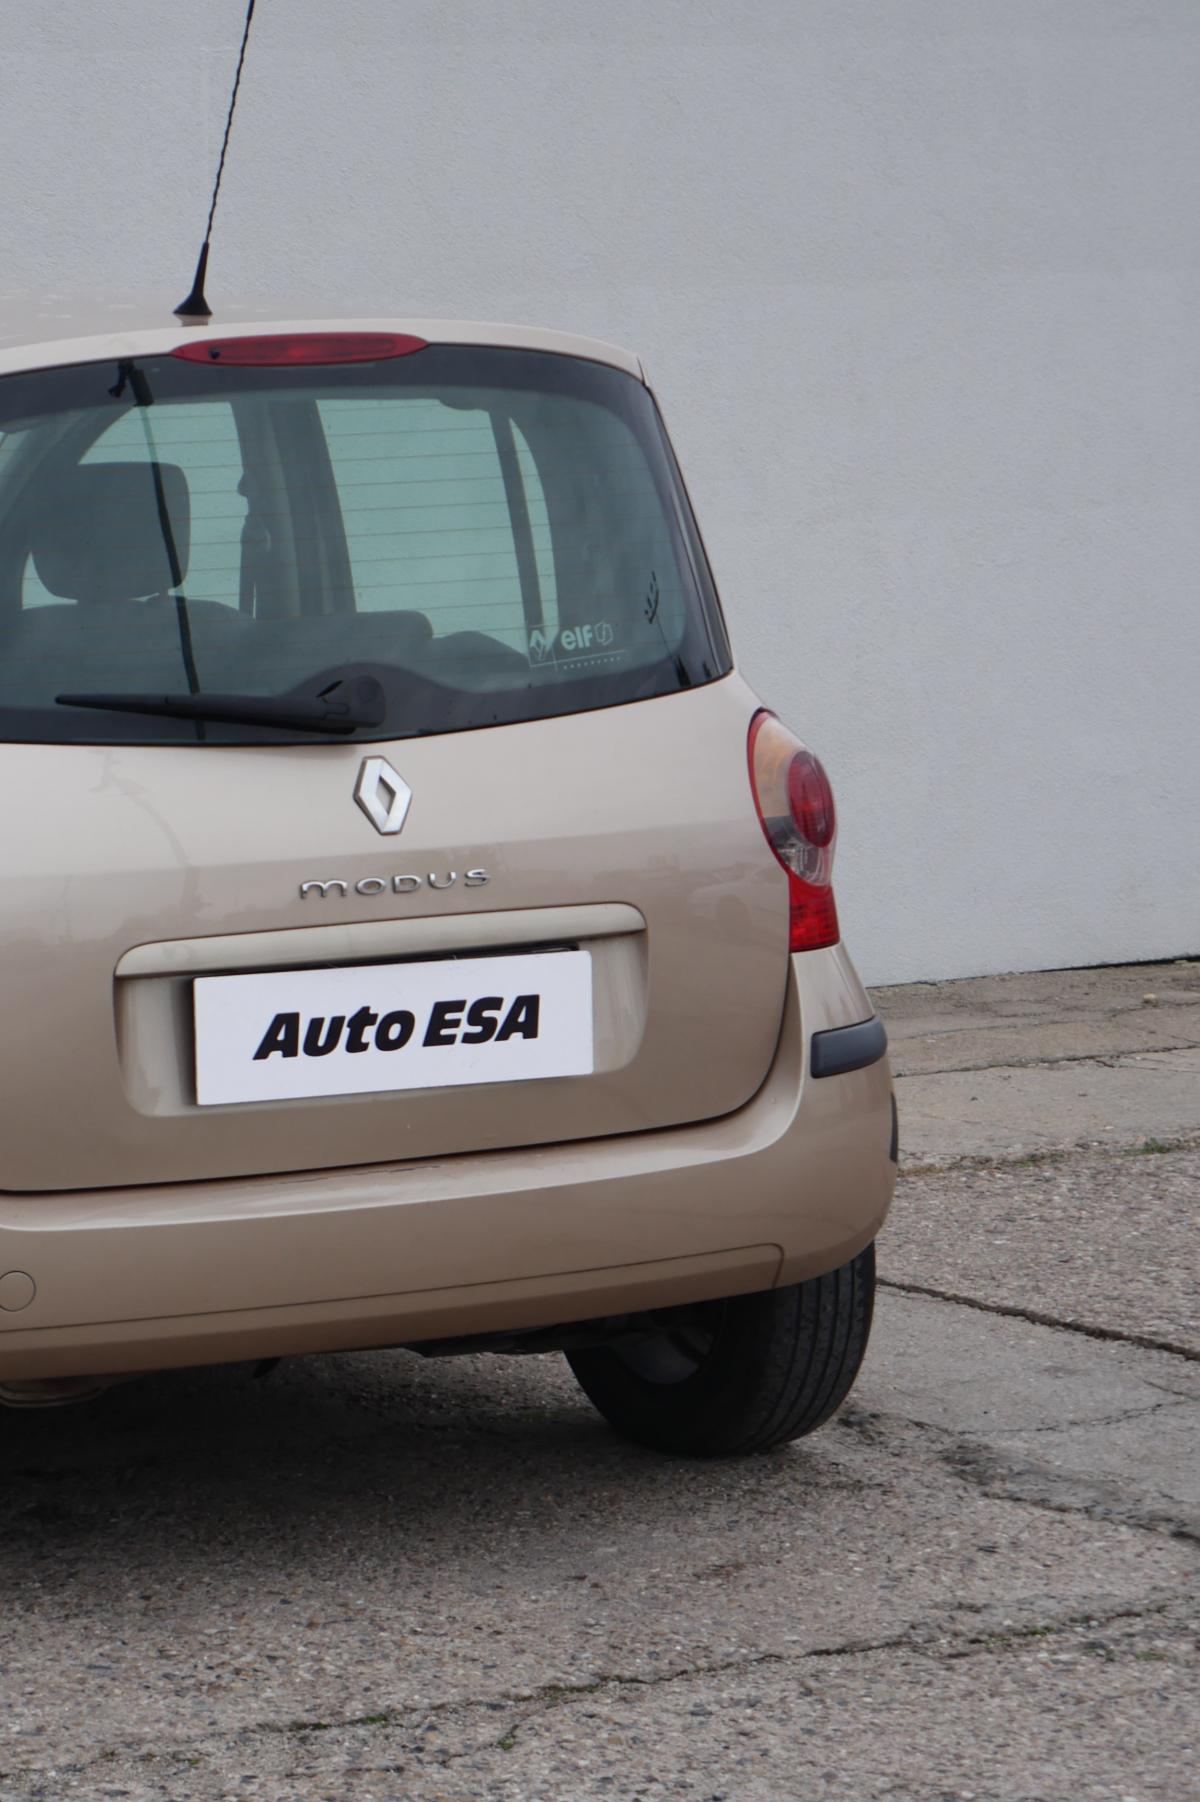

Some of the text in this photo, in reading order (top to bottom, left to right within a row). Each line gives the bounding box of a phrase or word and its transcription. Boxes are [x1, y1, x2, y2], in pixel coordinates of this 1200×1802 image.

[560, 624, 593, 650] elf
[252, 993, 541, 1061] Auto ESA
